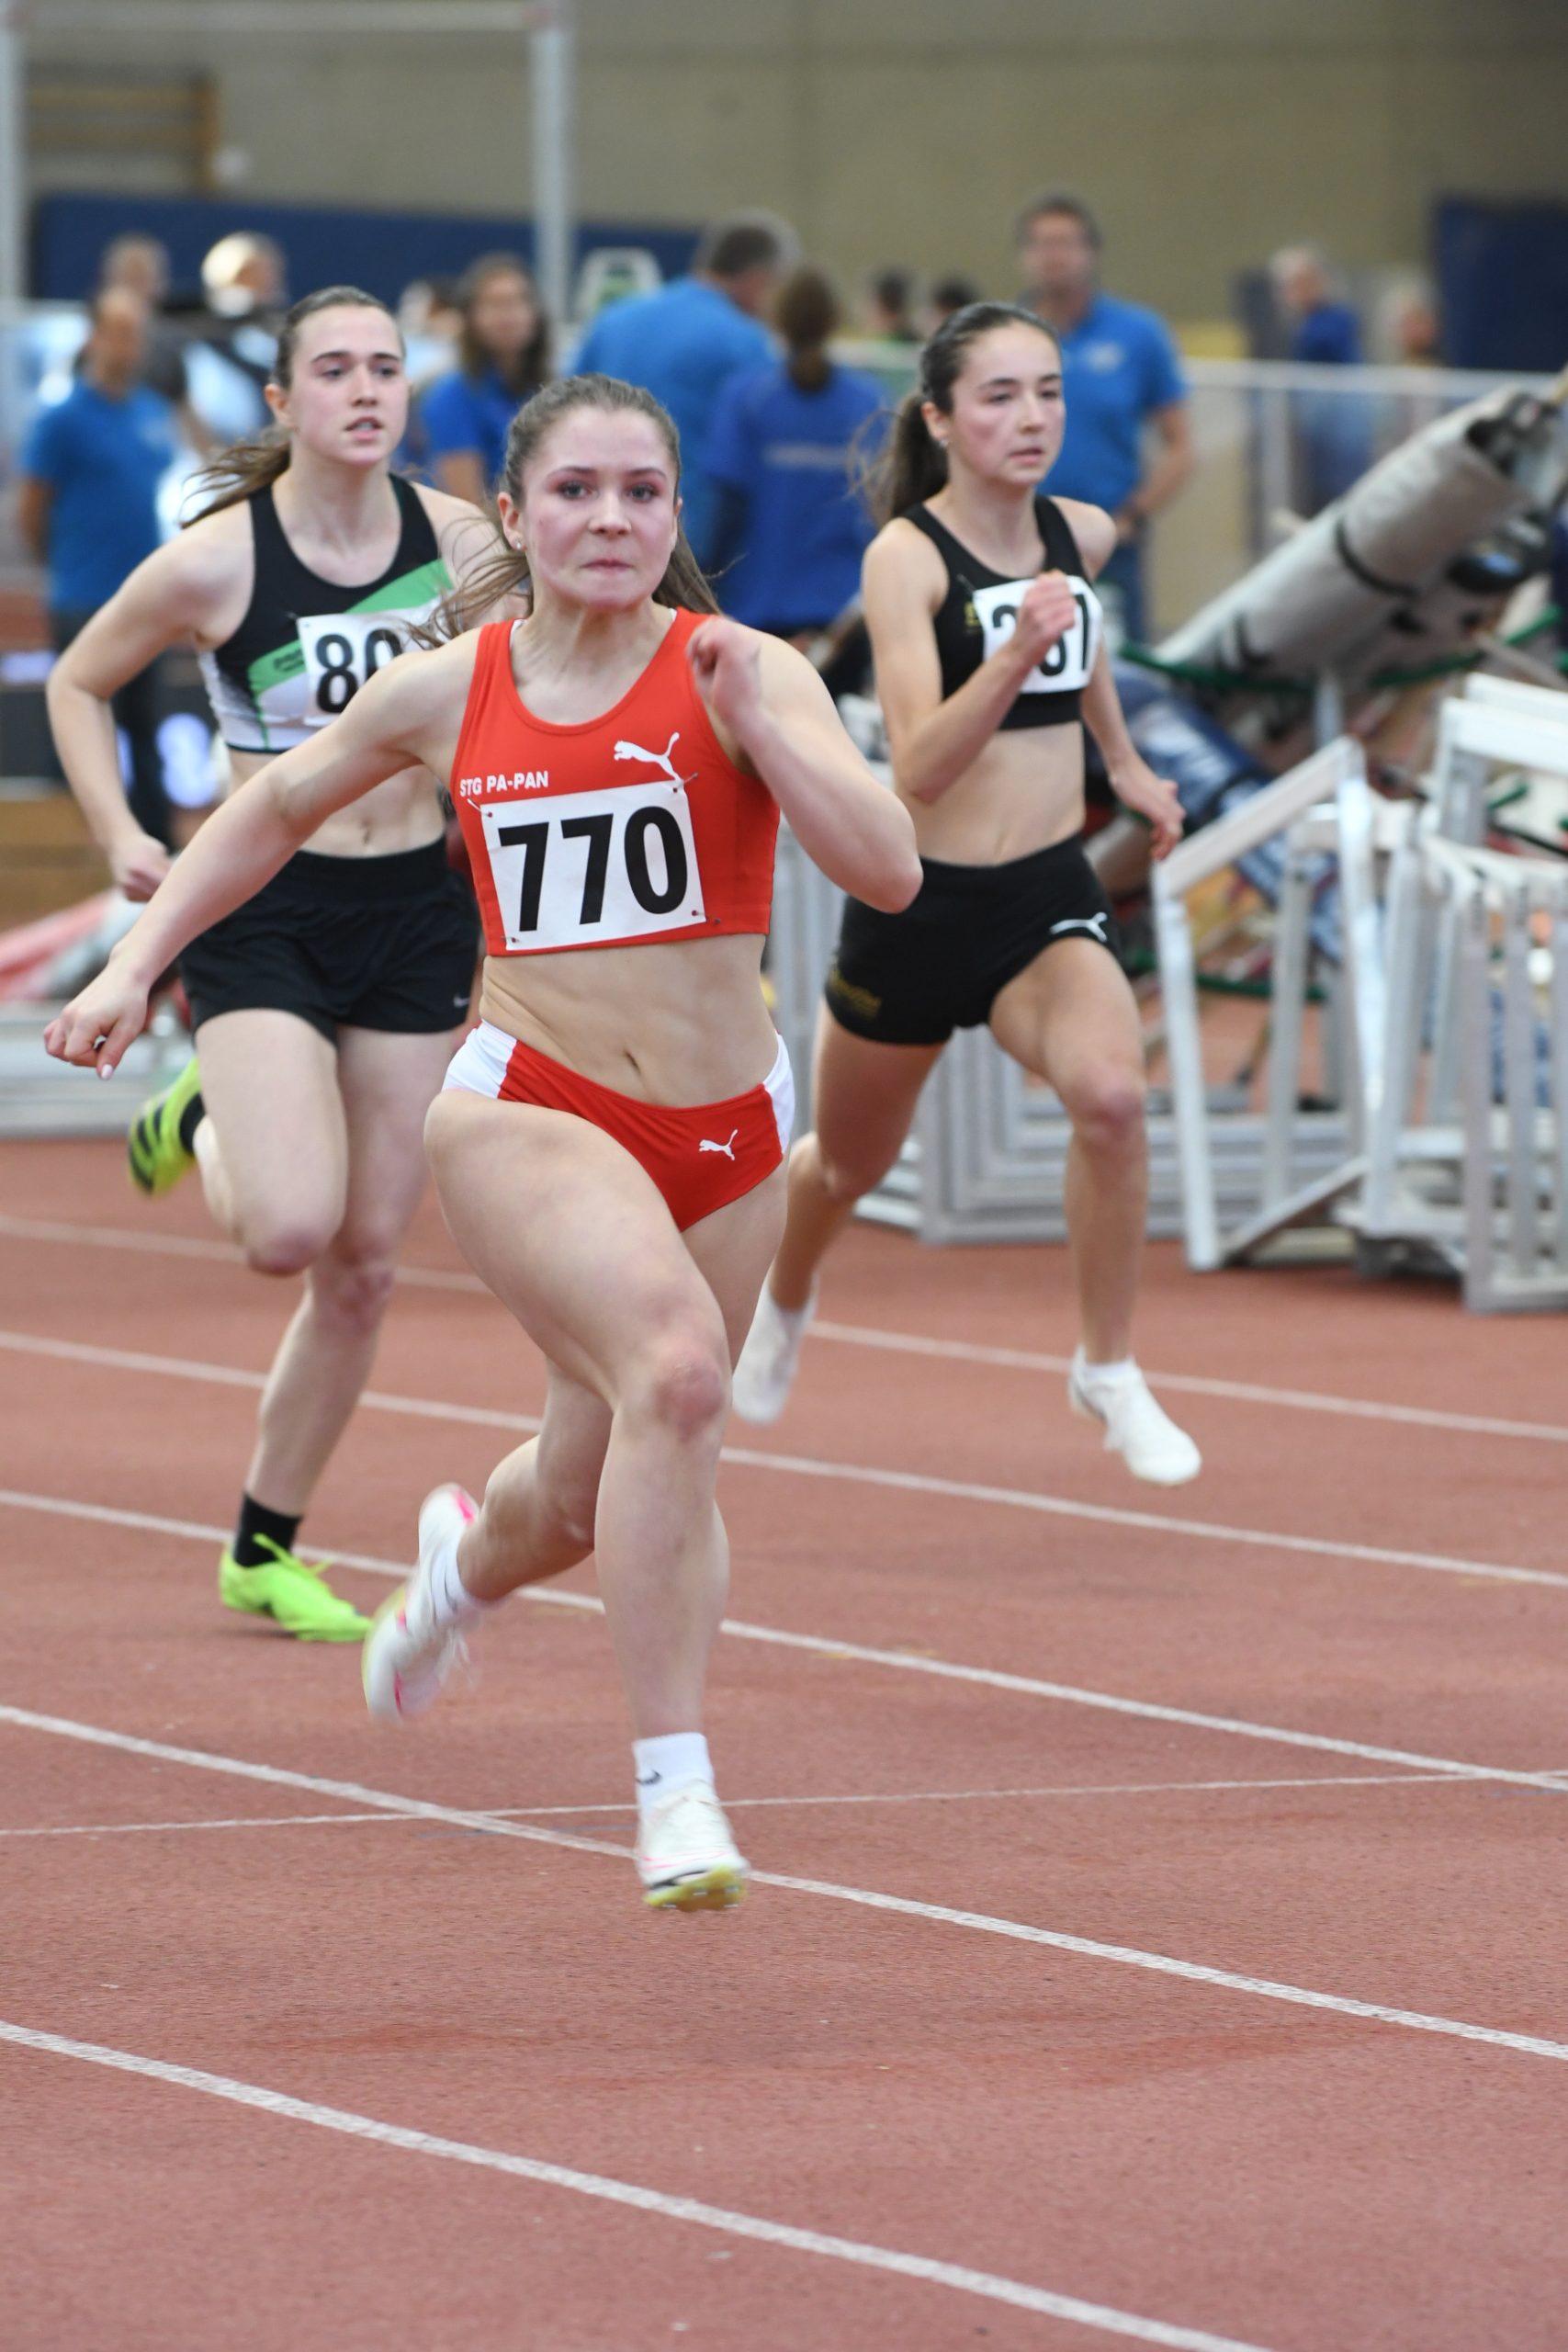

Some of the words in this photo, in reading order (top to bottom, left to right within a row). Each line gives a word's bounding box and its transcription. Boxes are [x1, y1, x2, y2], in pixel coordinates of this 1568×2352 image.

[459, 776, 482, 797] STG
[487, 770, 549, 793] PA-PAN
[497, 805, 688, 933] 770
